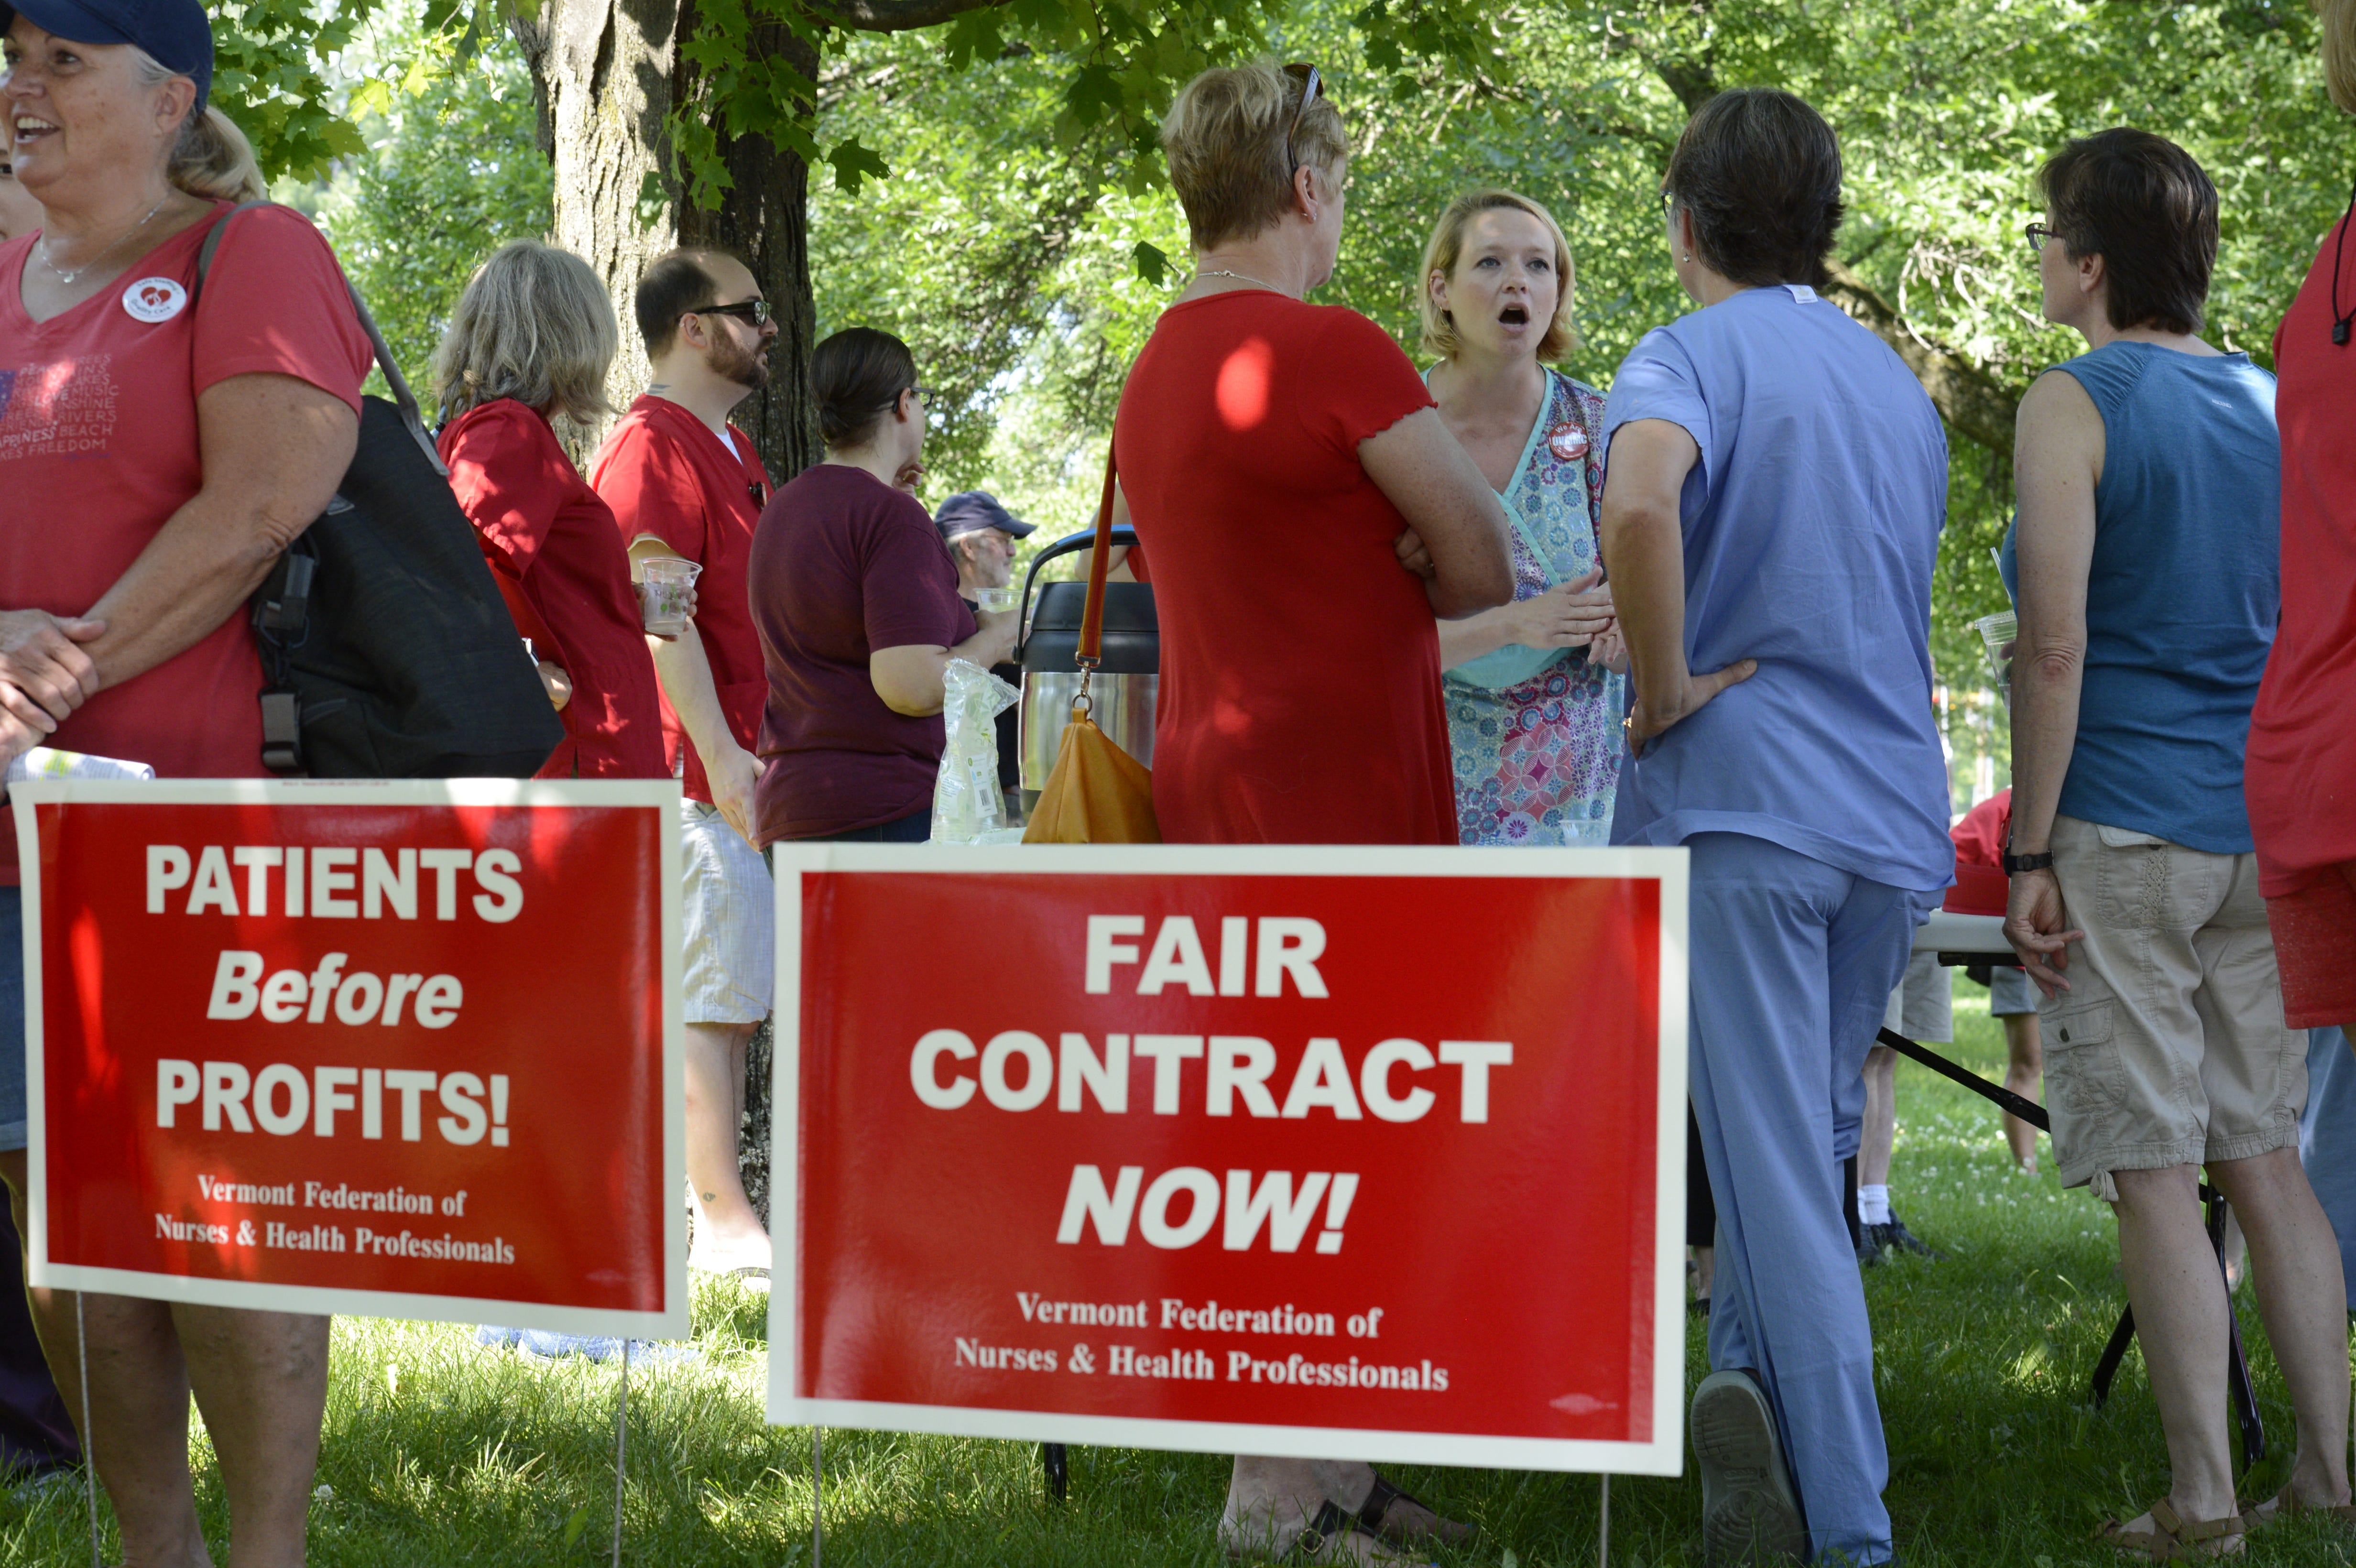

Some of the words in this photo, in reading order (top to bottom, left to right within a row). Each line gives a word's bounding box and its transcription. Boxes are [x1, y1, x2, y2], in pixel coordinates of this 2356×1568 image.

[57, 410, 117, 423] RIVERS
[59, 423, 113, 437] BEACH
[1555, 425, 1568, 433] We
[1570, 424, 1582, 433] Are
[28, 437, 107, 456] FREEDOM
[146, 844, 524, 923] PATIENTS
[1084, 915, 1329, 999] FAIR
[207, 949, 463, 1029] Before
[910, 1029, 1514, 1124] CONTRACT
[156, 1058, 510, 1148] PROFITS!
[197, 1174, 295, 1207] Vermont
[304, 1181, 434, 1215] Federation
[440, 1190, 468, 1217] of
[1056, 1164, 1360, 1254] NOW!
[155, 1213, 230, 1246] Nurses
[234, 1219, 257, 1248] &
[266, 1221, 346, 1252] Health
[355, 1227, 515, 1264] Professionals
[1016, 1291, 1147, 1328] Vermont
[1161, 1299, 1335, 1336] Federation
[1346, 1308, 1384, 1338] of
[955, 1337, 1058, 1371] Nurses
[1068, 1344, 1095, 1374] &
[1108, 1345, 1215, 1380] Health
[1227, 1351, 1449, 1391] Professionals
